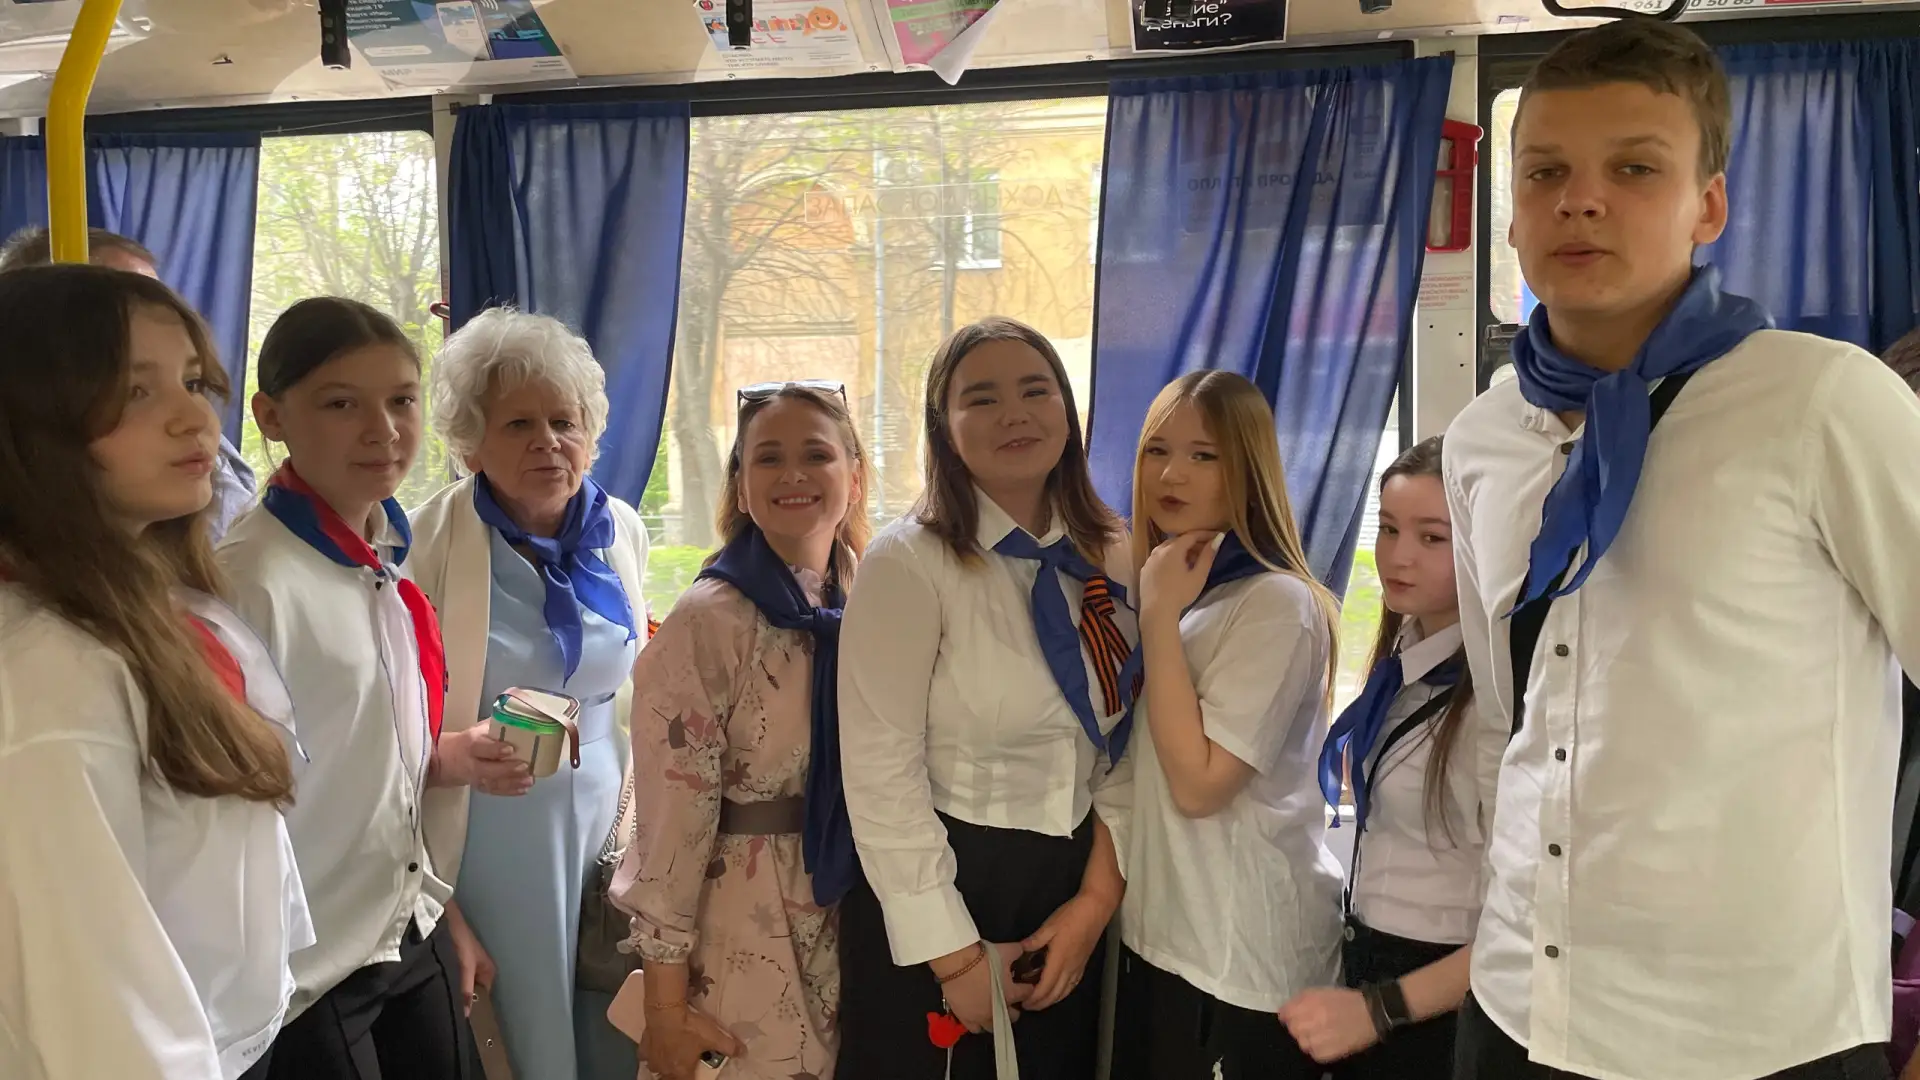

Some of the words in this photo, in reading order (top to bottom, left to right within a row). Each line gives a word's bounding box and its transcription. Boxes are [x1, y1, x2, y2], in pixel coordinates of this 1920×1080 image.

[1634, 0, 1663, 10] 961
[1187, 176, 1252, 192] ОПЛТ
[1258, 171, 1336, 188] ПРОДА
[968, 184, 1064, 210] ВЫХОД
